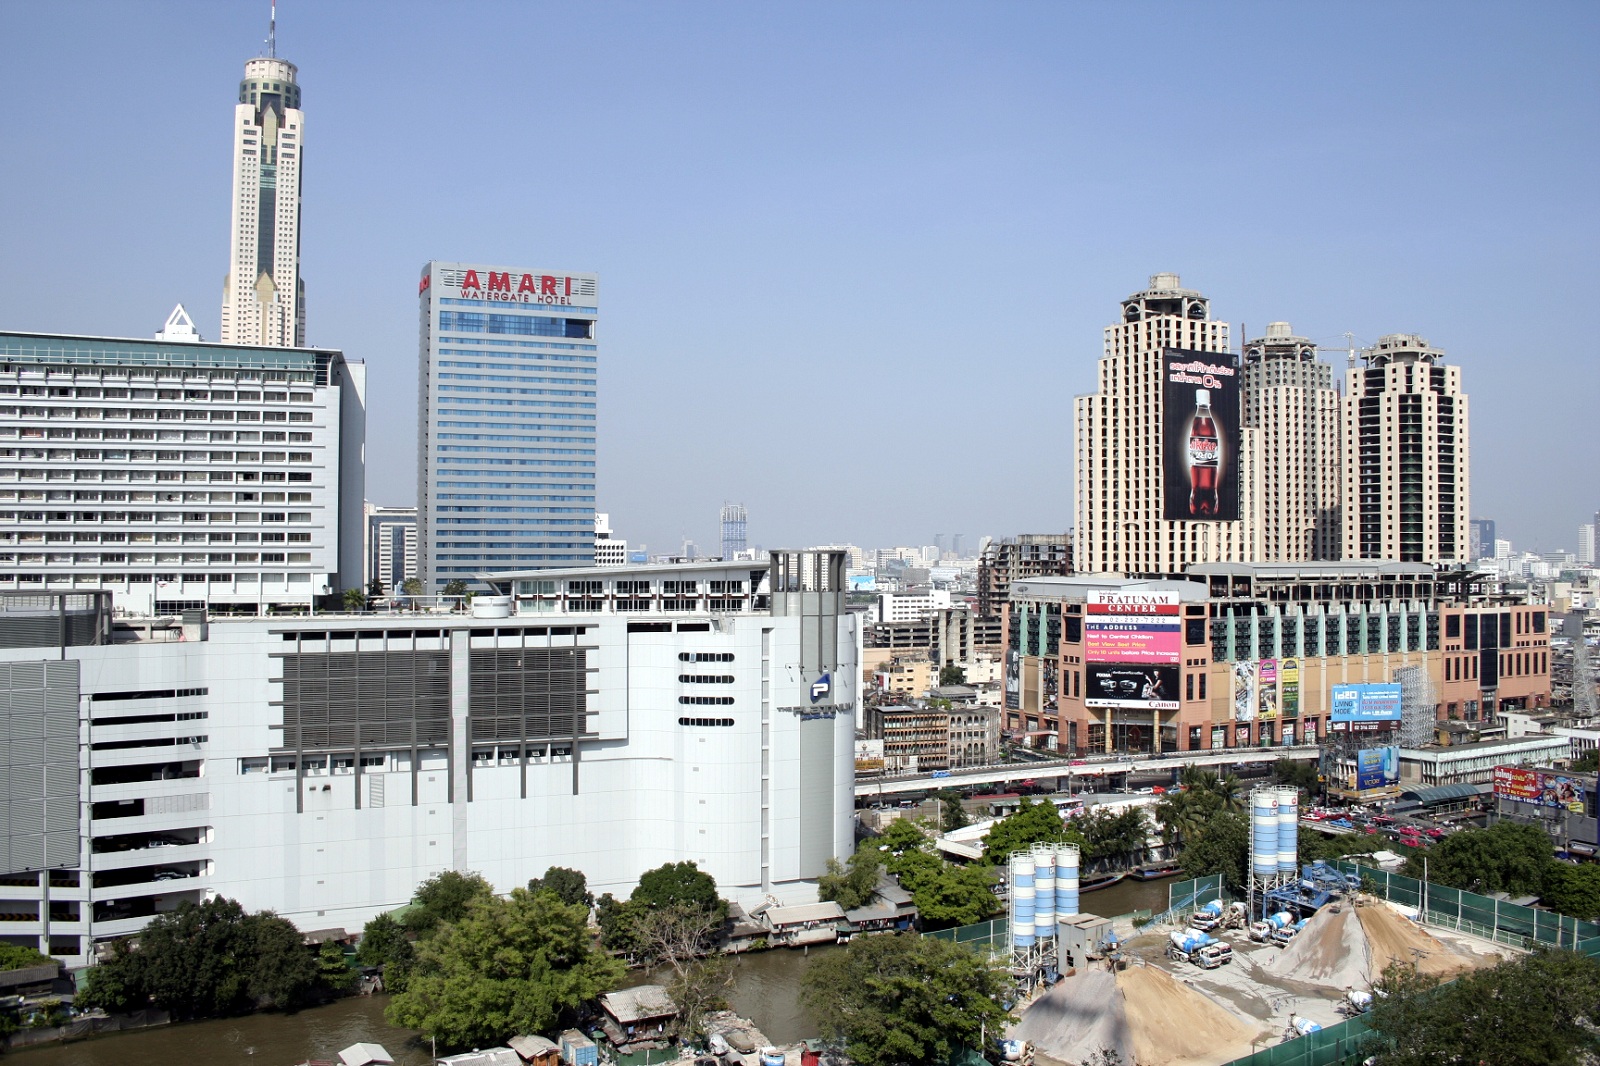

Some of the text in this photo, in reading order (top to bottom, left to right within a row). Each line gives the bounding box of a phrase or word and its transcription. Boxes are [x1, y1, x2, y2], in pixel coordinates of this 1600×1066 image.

[462, 269, 571, 296] AMARI
[461, 290, 572, 305] WATERGATE HOTEL
[1099, 596, 1169, 604] PRATUNAM
